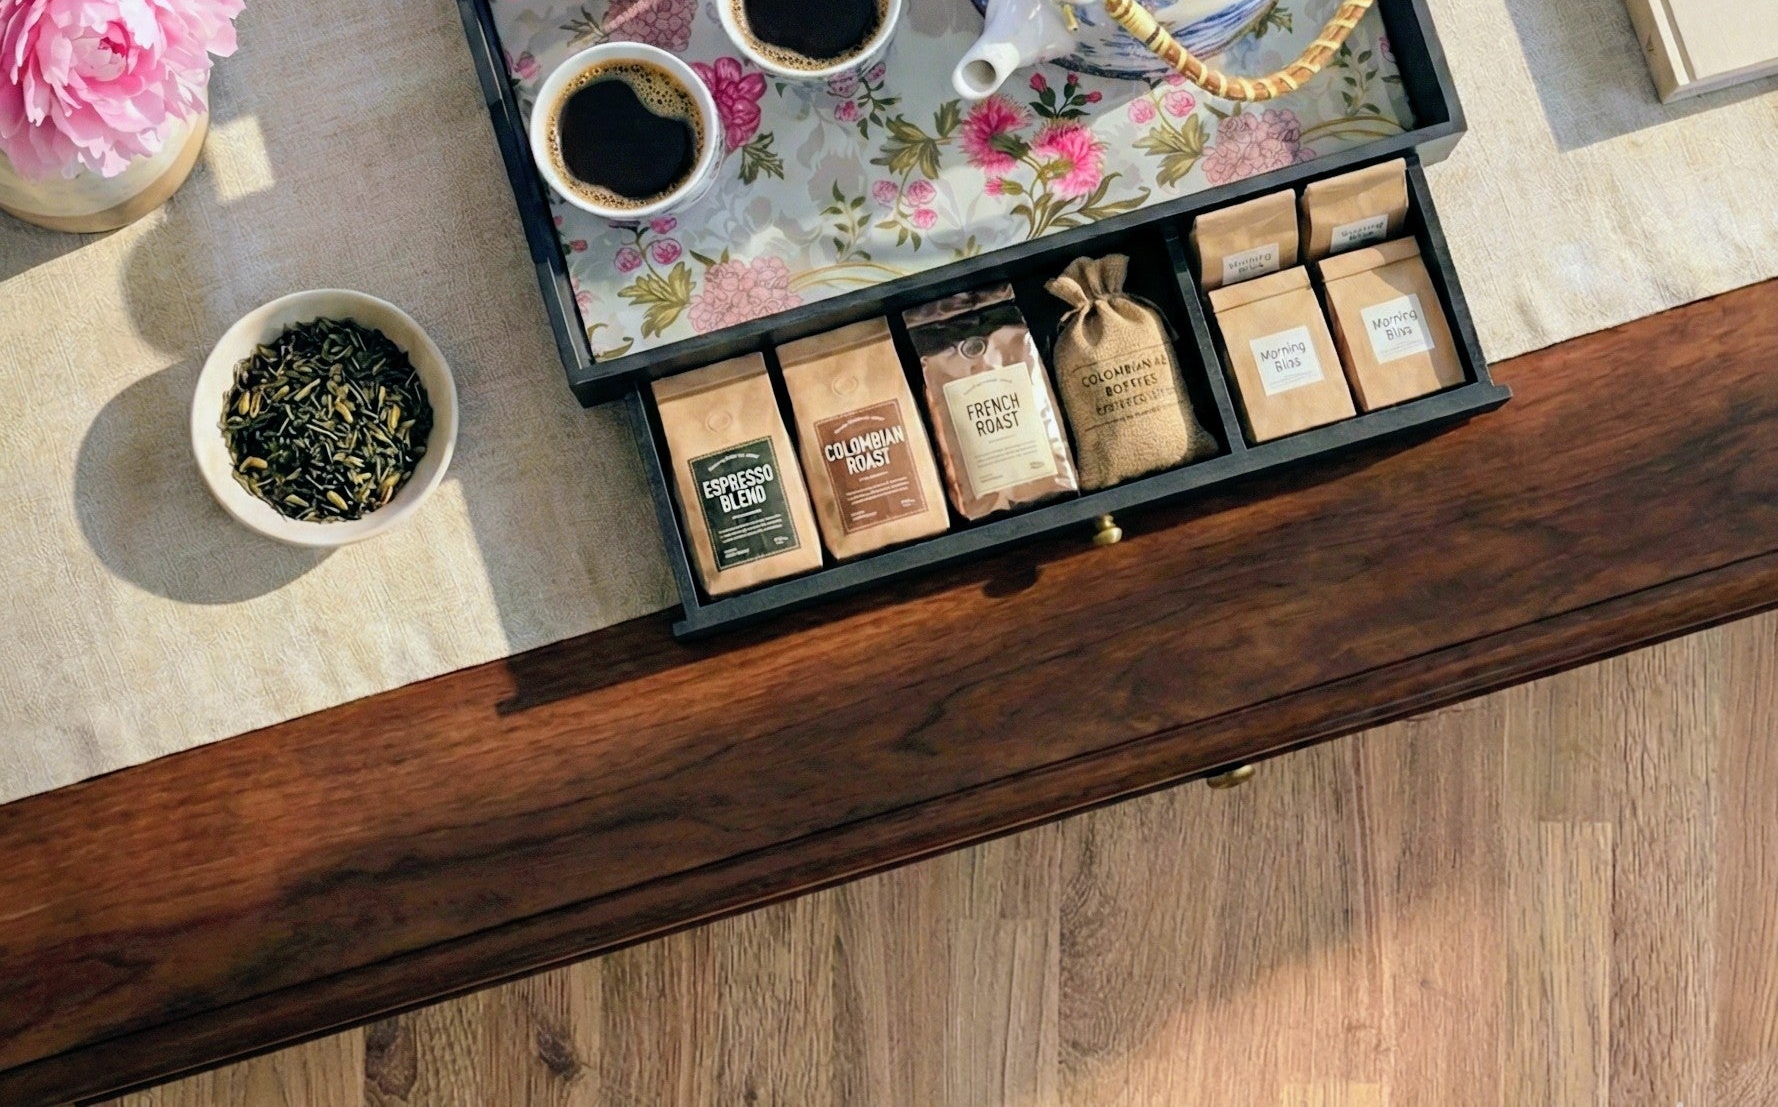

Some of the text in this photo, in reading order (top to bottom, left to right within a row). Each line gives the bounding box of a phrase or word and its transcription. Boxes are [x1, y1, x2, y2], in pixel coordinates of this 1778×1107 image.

[1260, 341, 1307, 362] Morning
[1081, 358, 1151, 388] COLOMBIAN
[966, 392, 1020, 421] FRENCH
[975, 410, 1020, 437] ROAST
[824, 425, 905, 463] COLOMBIAN
[845, 446, 891, 476] ROAST
[702, 463, 774, 499] ESPRESSO
